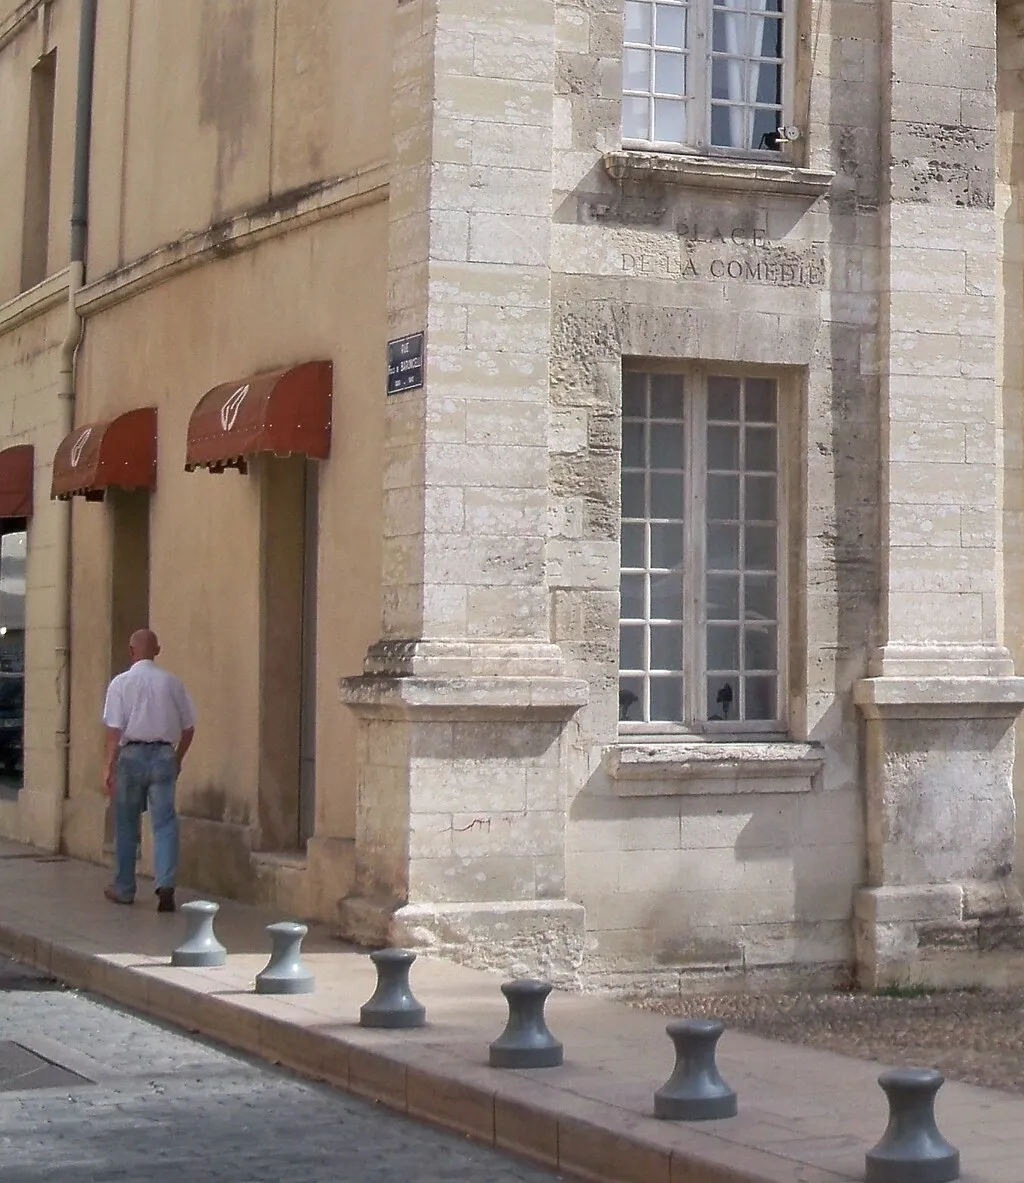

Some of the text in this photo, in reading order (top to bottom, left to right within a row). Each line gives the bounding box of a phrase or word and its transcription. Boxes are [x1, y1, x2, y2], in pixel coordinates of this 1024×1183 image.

[674, 222, 768, 248] PLACE
[621, 252, 653, 272] DE
[665, 254, 699, 276] LA
